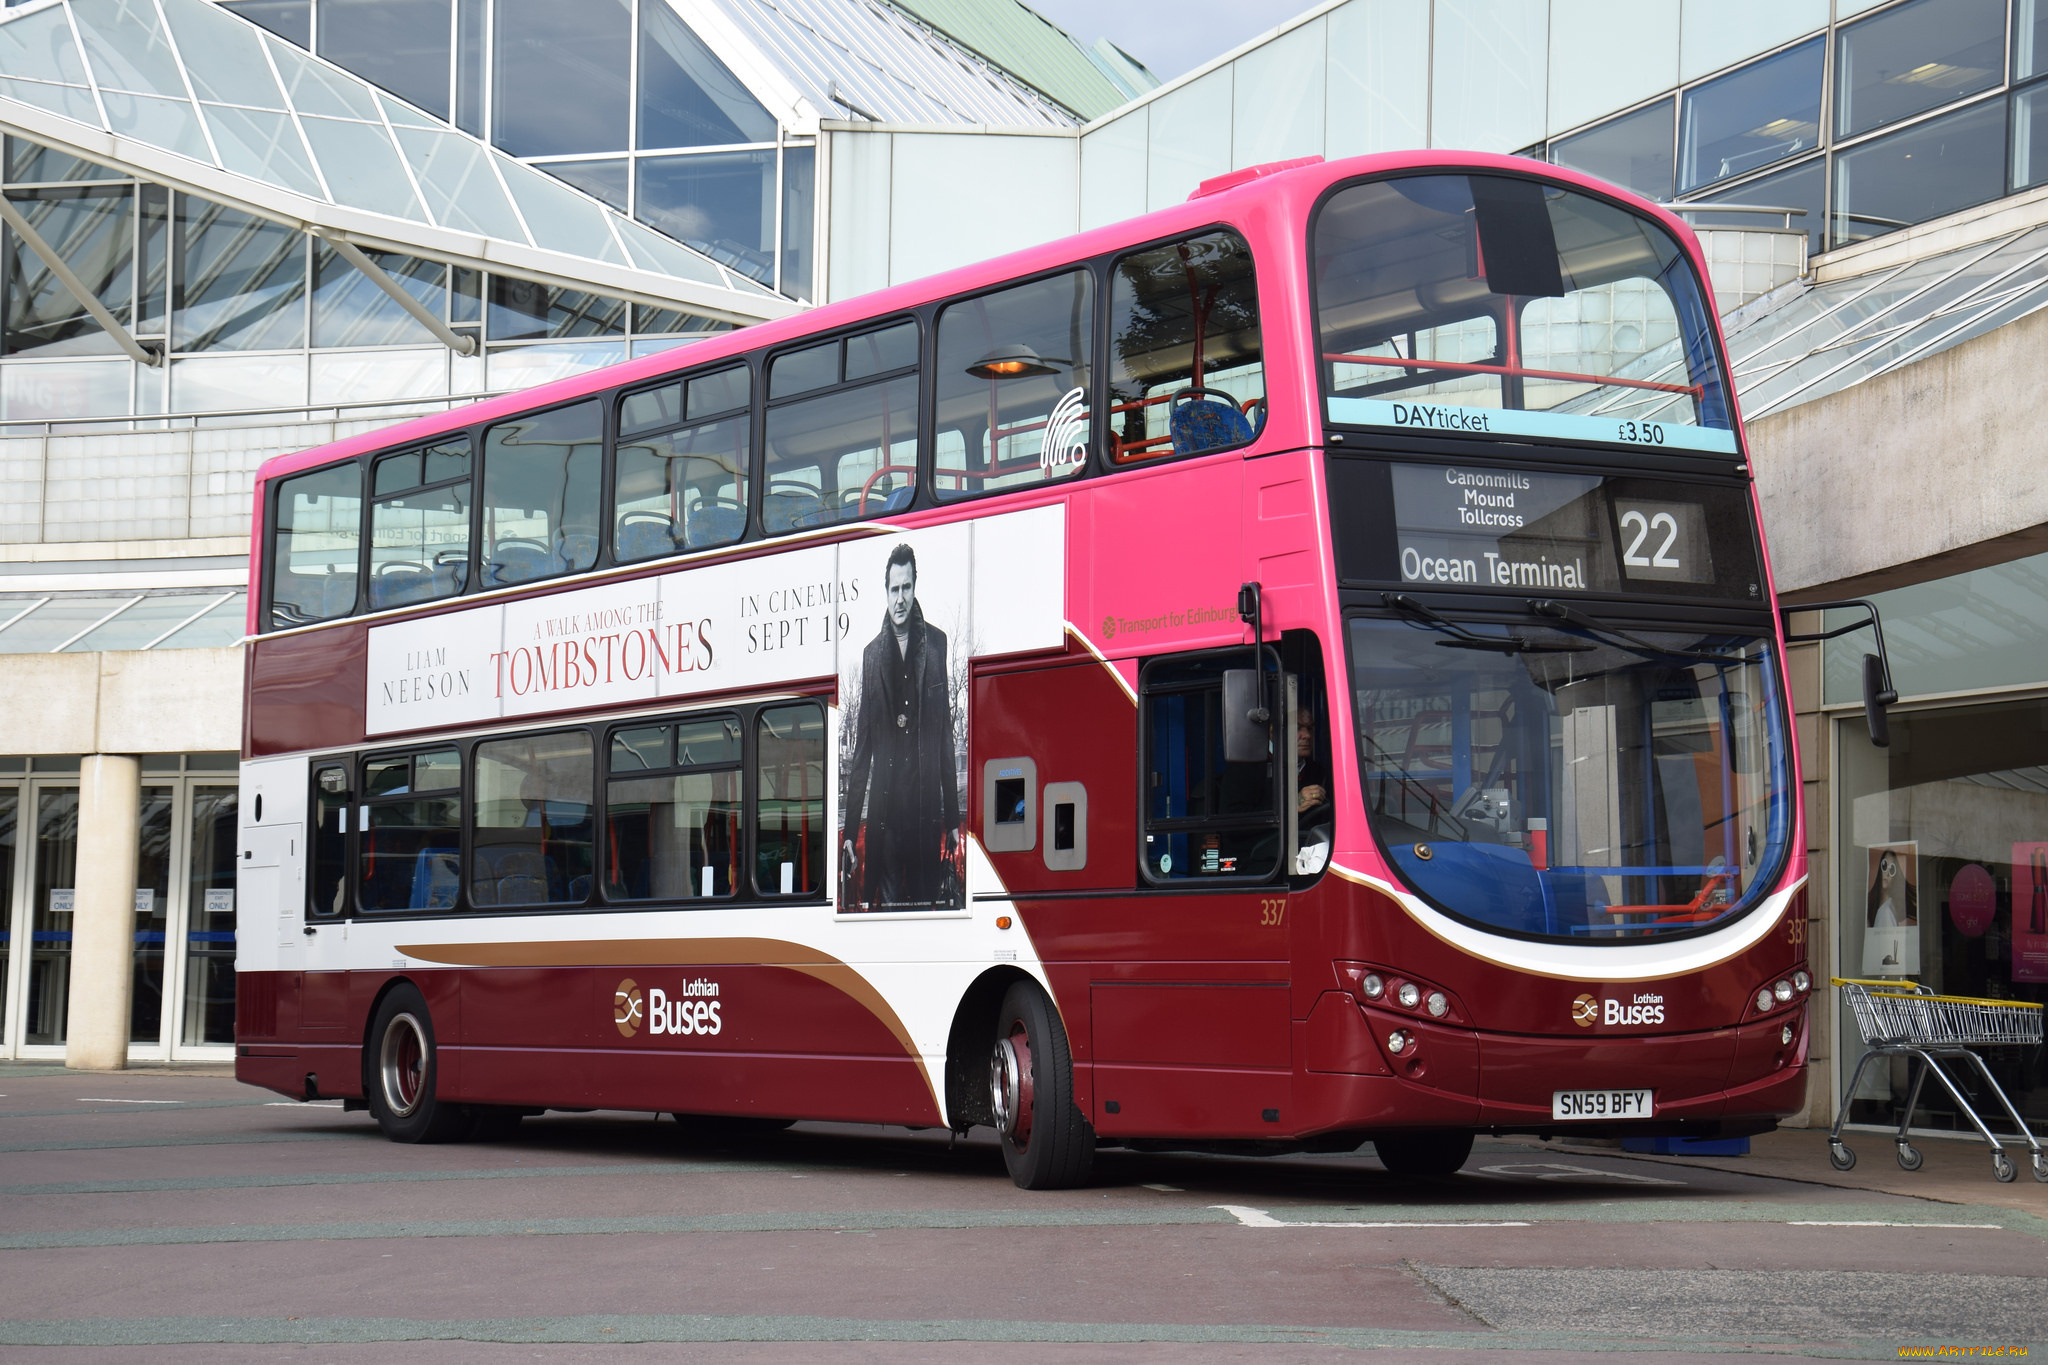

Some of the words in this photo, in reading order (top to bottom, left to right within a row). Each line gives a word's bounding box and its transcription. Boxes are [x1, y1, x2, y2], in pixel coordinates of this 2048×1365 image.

[1393, 404, 1490, 431] DAYticket
[1619, 421, 1664, 444] £3.50
[1446, 468, 1530, 490] Canonmills
[1464, 489, 1515, 508] Mound
[1458, 507, 1524, 527] Tollcross
[1621, 510, 1679, 568] 22
[1402, 547, 1477, 582] Ocean
[1484, 552, 1586, 588] Terminal
[741, 595, 759, 618] IN
[769, 578, 859, 613] CINEMAS
[533, 622, 542, 640] A
[546, 614, 580, 637] WALK
[584, 606, 632, 632] AMONG
[638, 600, 664, 623] THE
[748, 617, 809, 654] SEPT
[822, 612, 850, 642] 19
[1117, 613, 1168, 634] Transport
[1170, 611, 1185, 627] for
[407, 647, 446, 671] LIAM
[490, 618, 713, 698] TOMBSTONES
[383, 669, 470, 706] NEESON
[1260, 899, 1286, 925] 337
[1787, 919, 1807, 944] 337
[683, 978, 719, 997] Lothian
[1634, 993, 1663, 1004] Lothian
[650, 988, 721, 1035] Buses
[1604, 999, 1665, 1025] Buses
[1561, 1094, 1606, 1115] SN59
[1611, 1092, 1644, 1114] BFY
